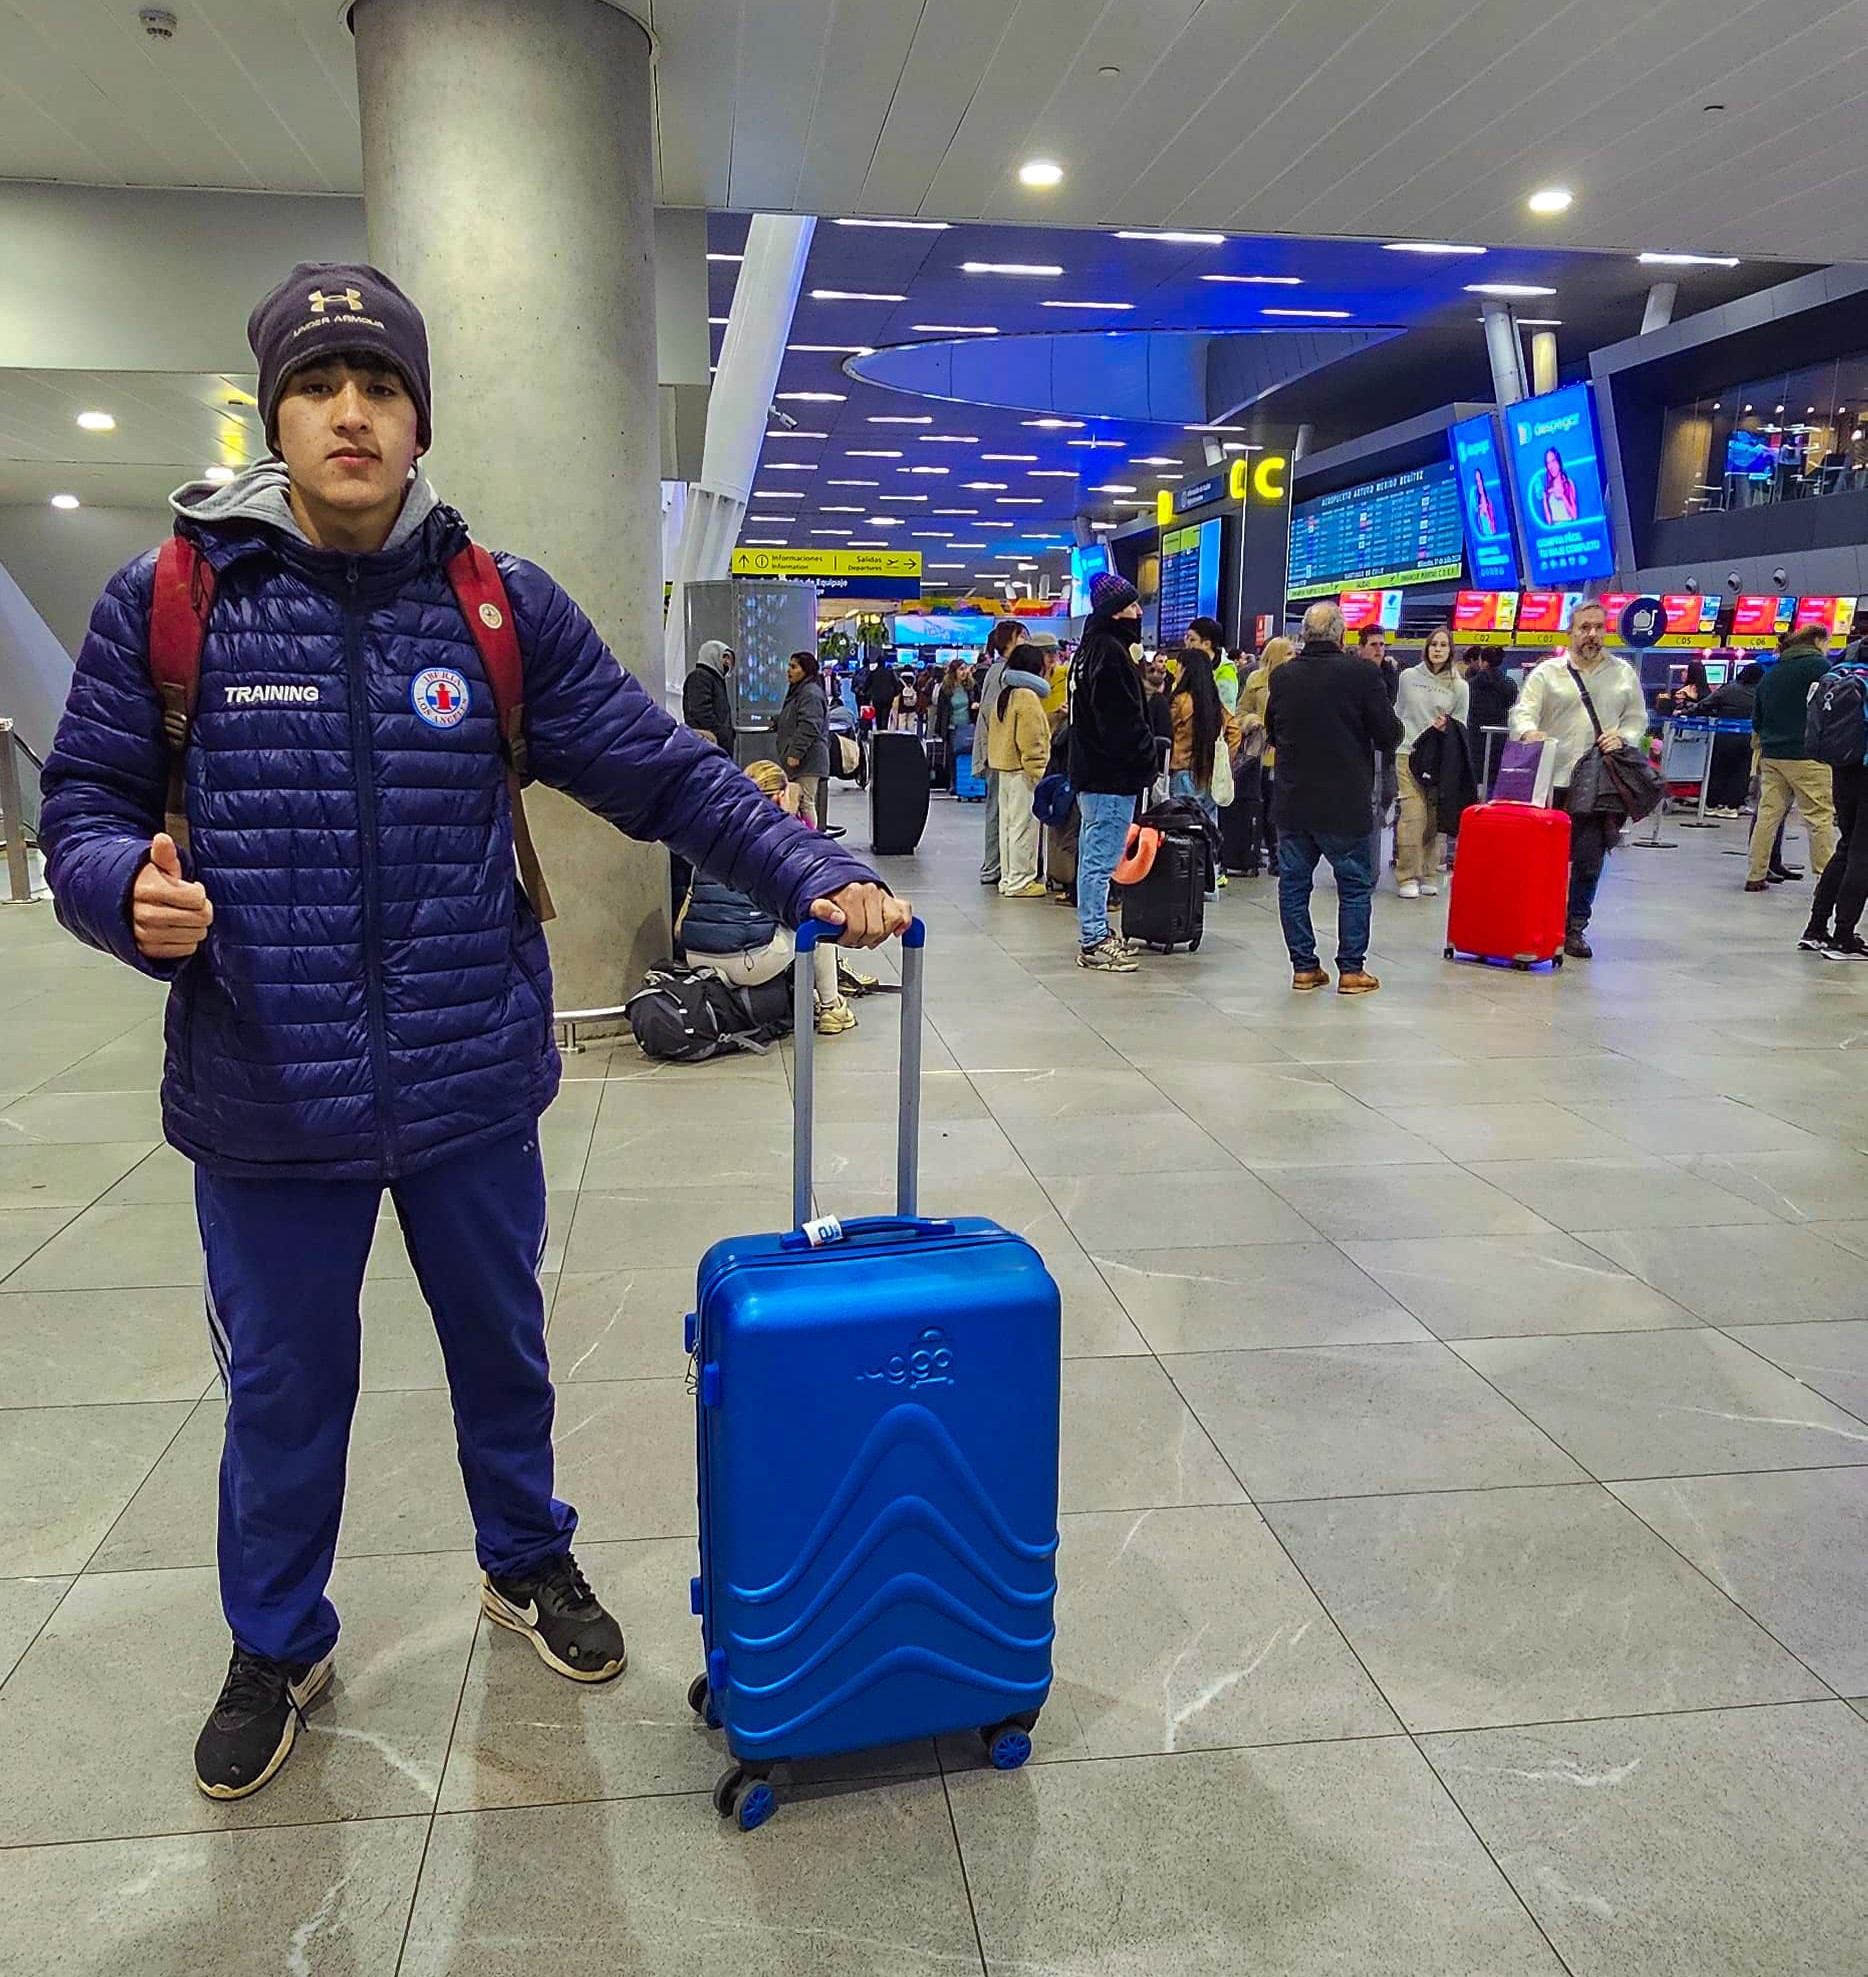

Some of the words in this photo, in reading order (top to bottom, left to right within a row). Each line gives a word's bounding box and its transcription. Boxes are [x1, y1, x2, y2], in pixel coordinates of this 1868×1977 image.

[293, 316, 331, 337] UNDER
[334, 314, 385, 330] ARMOUR
[1254, 456, 1286, 499] C
[771, 553, 823, 562] Informaciones
[856, 555, 882, 564] Salidas
[848, 564, 882, 572] Departures
[224, 685, 319, 703] TRAINING
